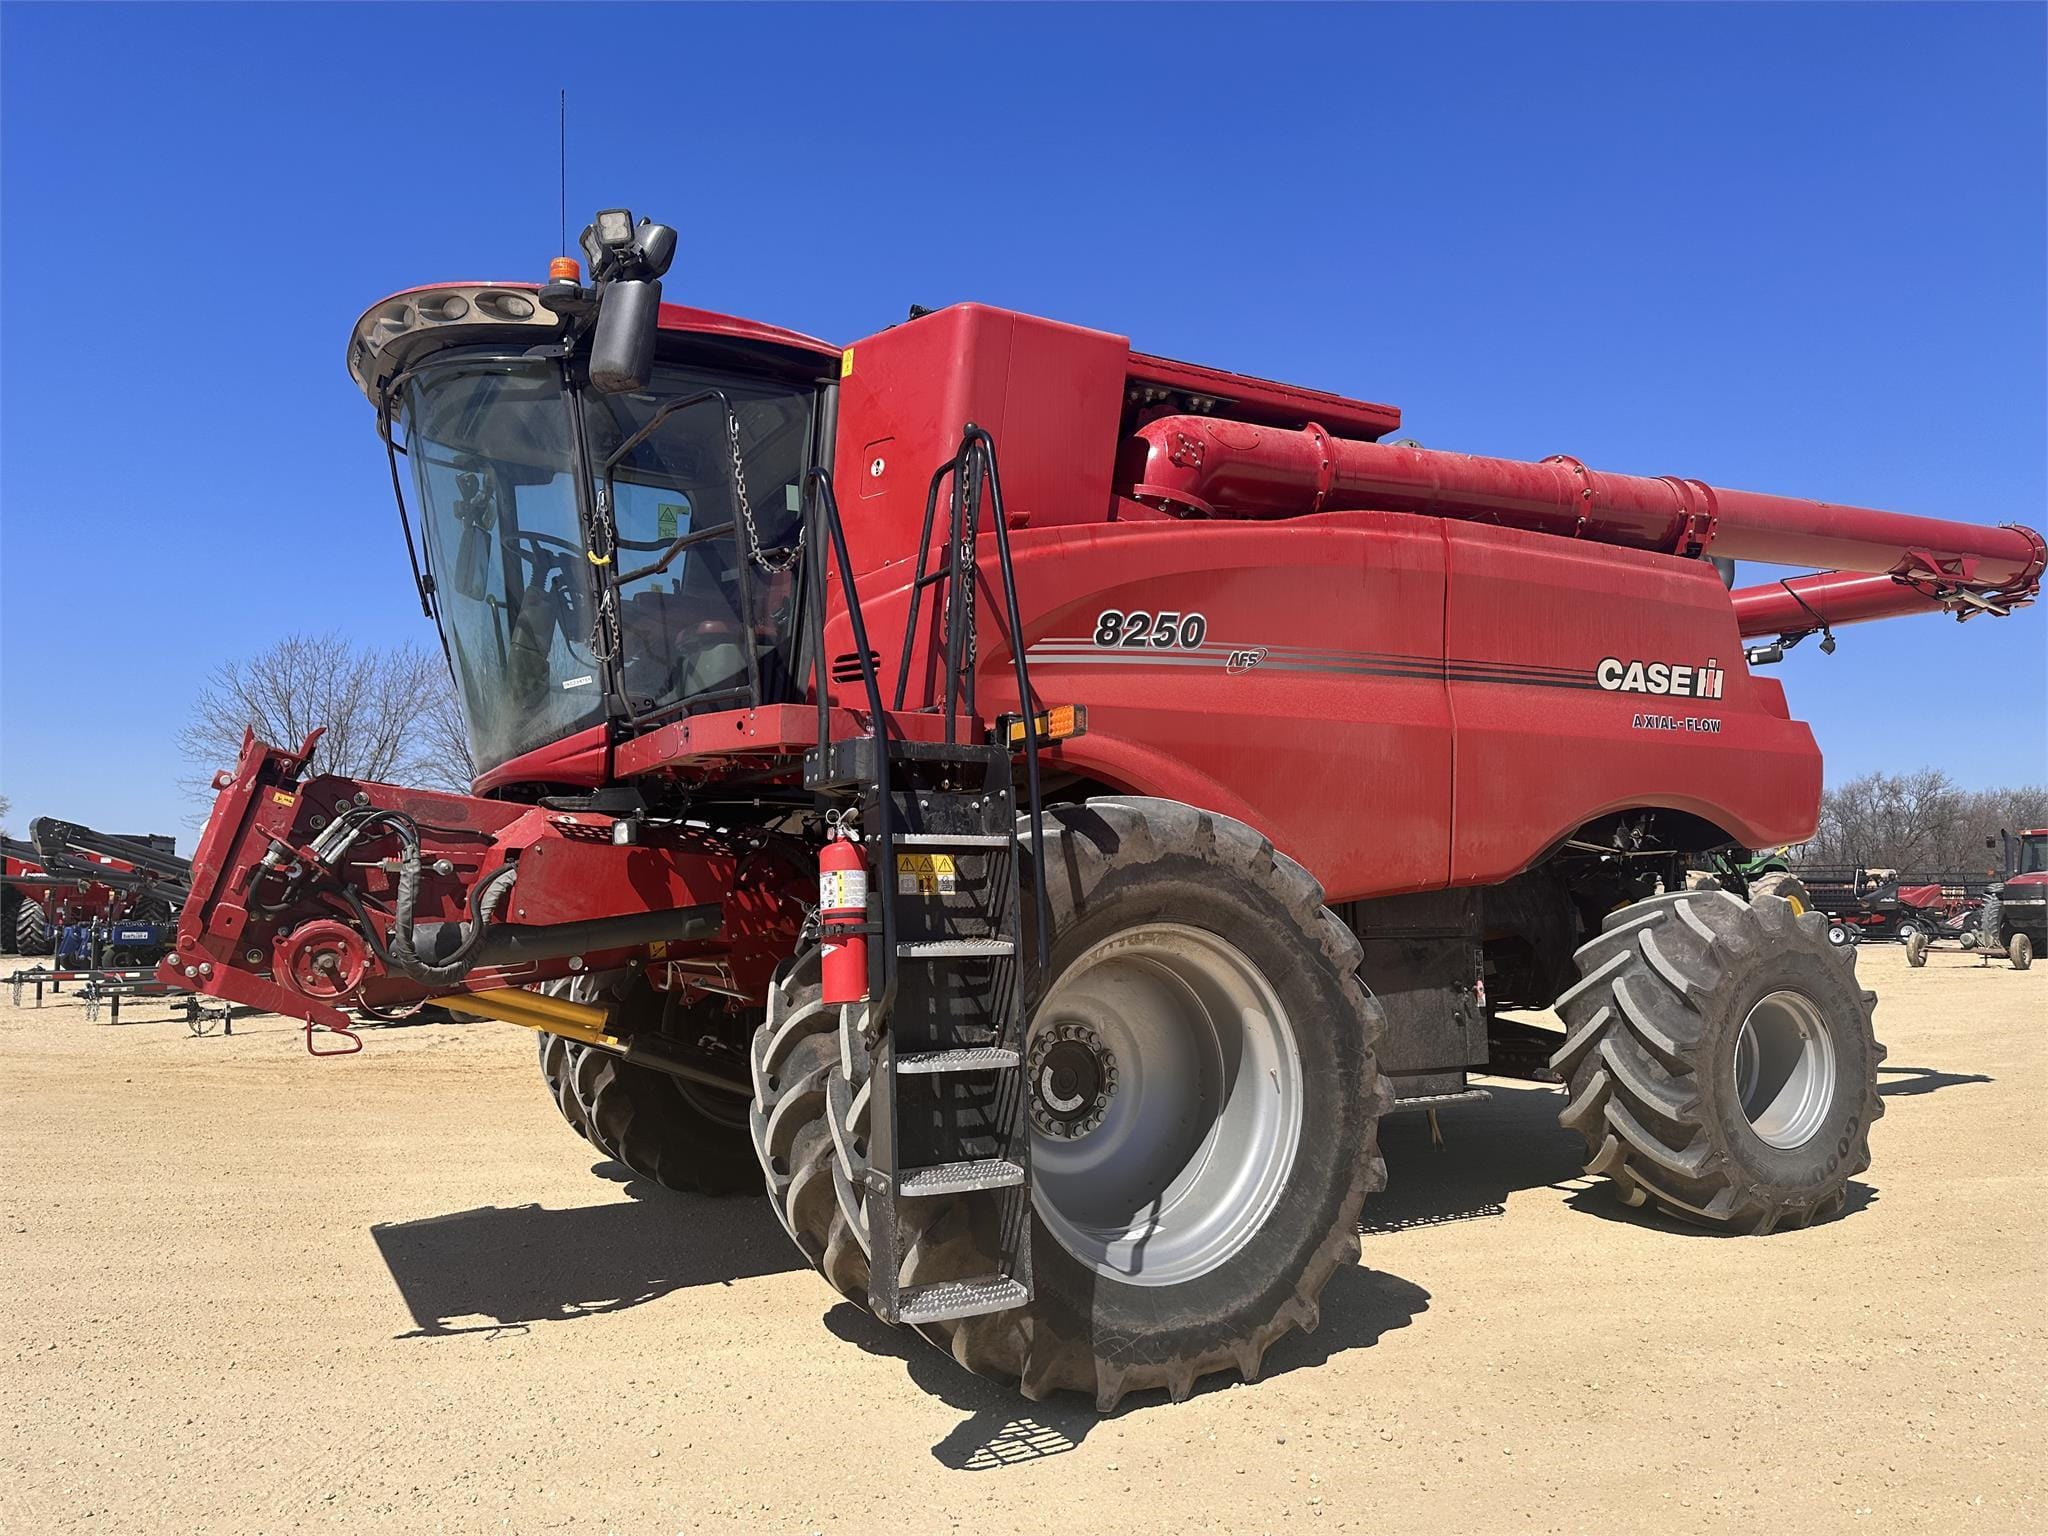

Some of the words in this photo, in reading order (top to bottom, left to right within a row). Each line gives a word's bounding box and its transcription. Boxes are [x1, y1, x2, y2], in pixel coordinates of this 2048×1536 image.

[1094, 609, 1206, 650] 8250
[1226, 651, 1260, 667] AFS
[1597, 658, 1692, 695] CASE
[1632, 713, 1721, 733] AXIAL-FLOW
